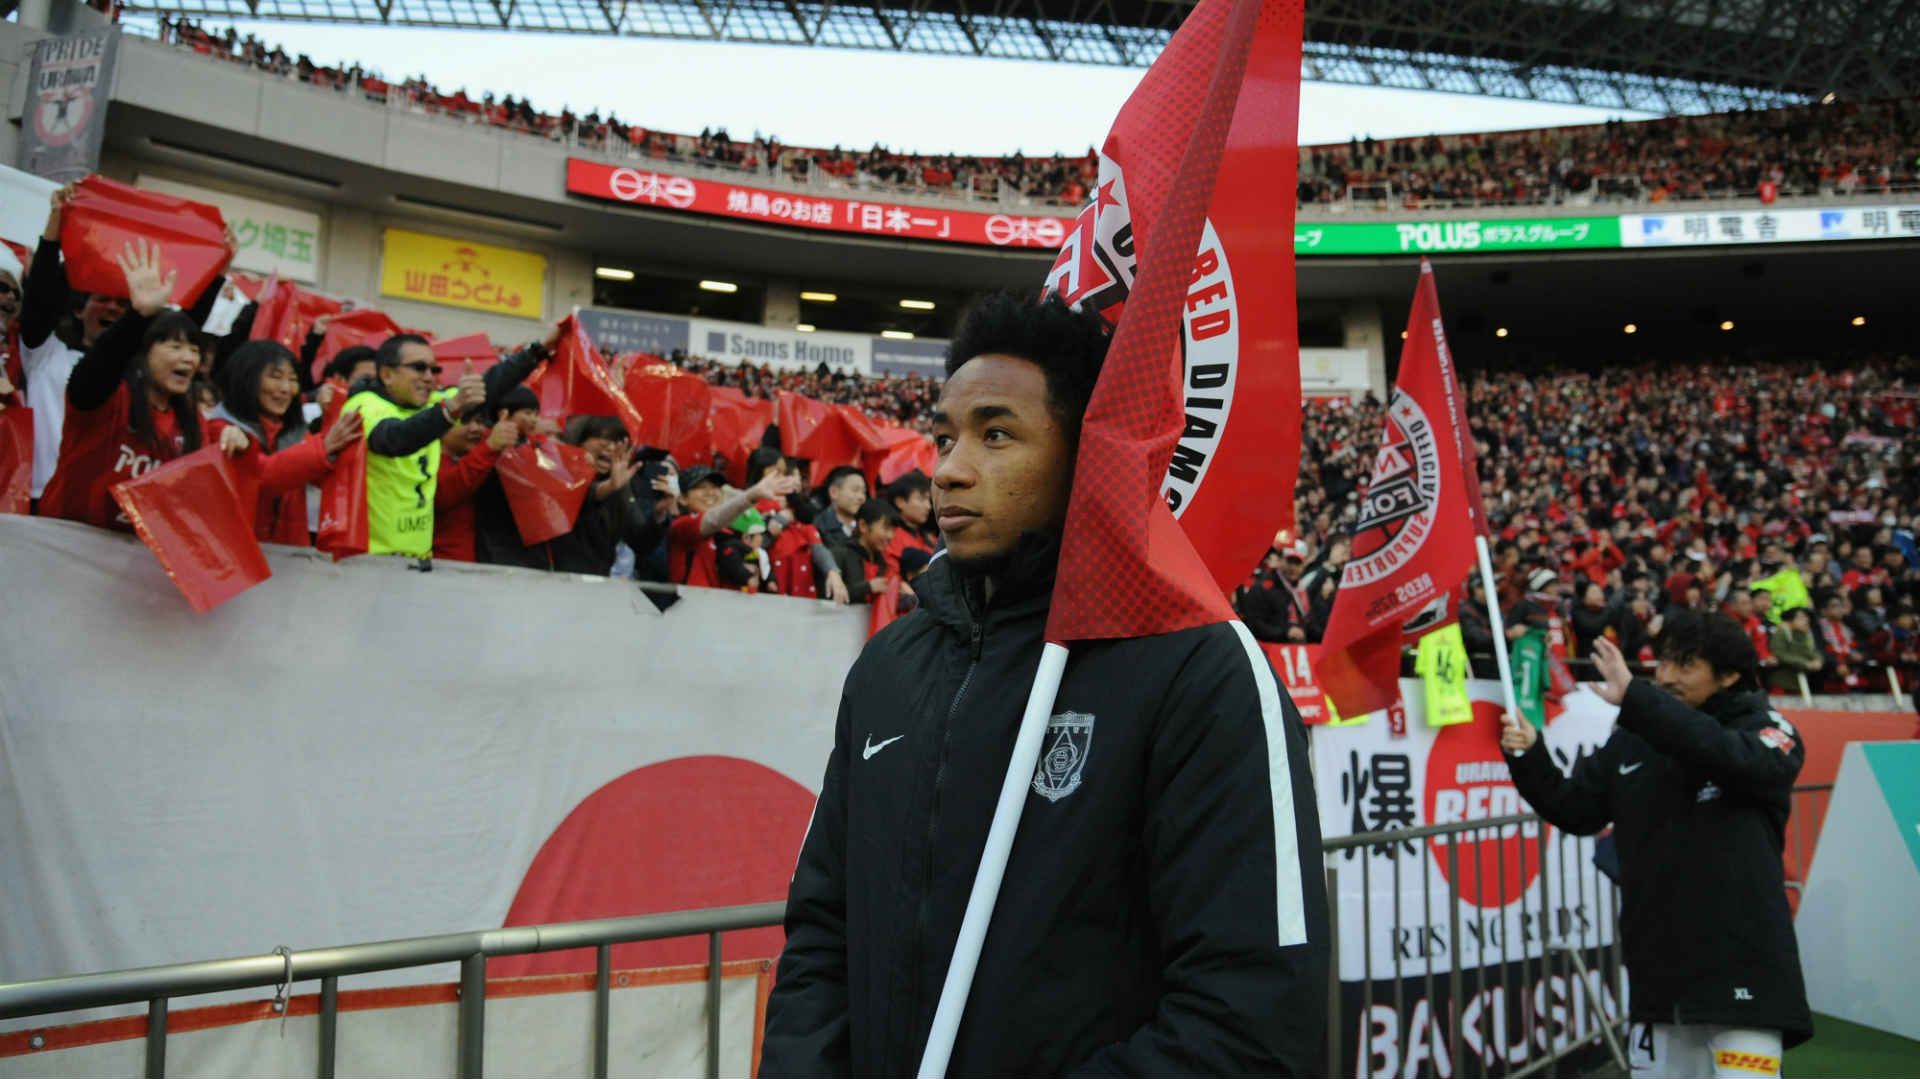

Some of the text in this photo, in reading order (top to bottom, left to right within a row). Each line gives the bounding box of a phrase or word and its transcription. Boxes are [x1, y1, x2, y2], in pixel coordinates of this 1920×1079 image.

[1397, 221, 1482, 250] POLUS
[731, 332, 789, 361] Sams
[795, 341, 854, 365] Home
[1280, 645, 1313, 687] 14
[1390, 924, 1503, 962] RISNG
[1733, 987, 1753, 1000] XL
[1719, 1052, 1779, 1071] DHL
